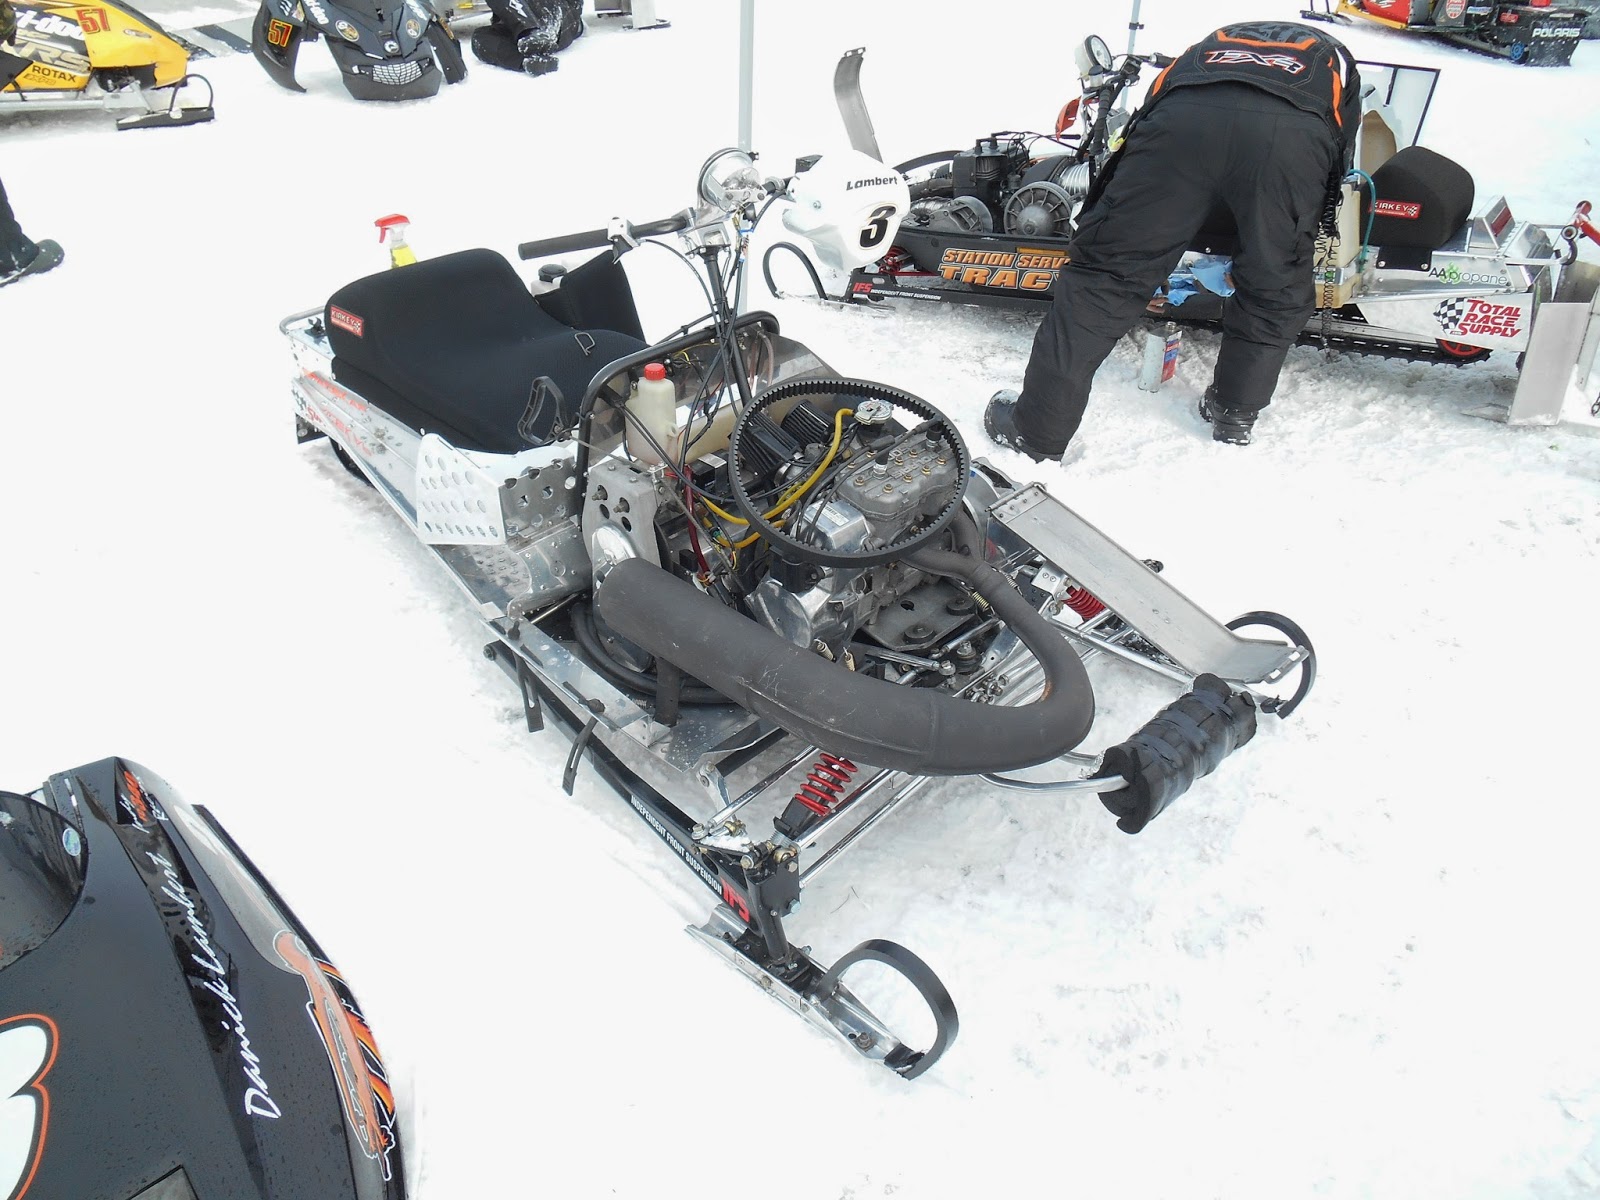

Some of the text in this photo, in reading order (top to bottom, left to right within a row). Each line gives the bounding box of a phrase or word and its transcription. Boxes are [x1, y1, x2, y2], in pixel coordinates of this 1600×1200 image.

[76, 7, 111, 34] 57
[268, 19, 293, 47] 57
[1532, 27, 1581, 38] POLARIS
[32, 64, 77, 83] ROTAX
[846, 176, 898, 191] Lambert
[859, 205, 897, 248] 3
[943, 249, 1015, 268] STATION
[939, 264, 1060, 290] TRAC
[852, 282, 873, 293] IFS
[1466, 299, 1522, 317] TOTAL
[1463, 313, 1519, 327] RACE
[1458, 323, 1522, 337] SUPPLY
[631, 795, 667, 838] INDEPENDENT
[666, 831, 685, 857] FRONT
[685, 850, 722, 896] SUSPENSION
[145, 851, 227, 975] Lambert
